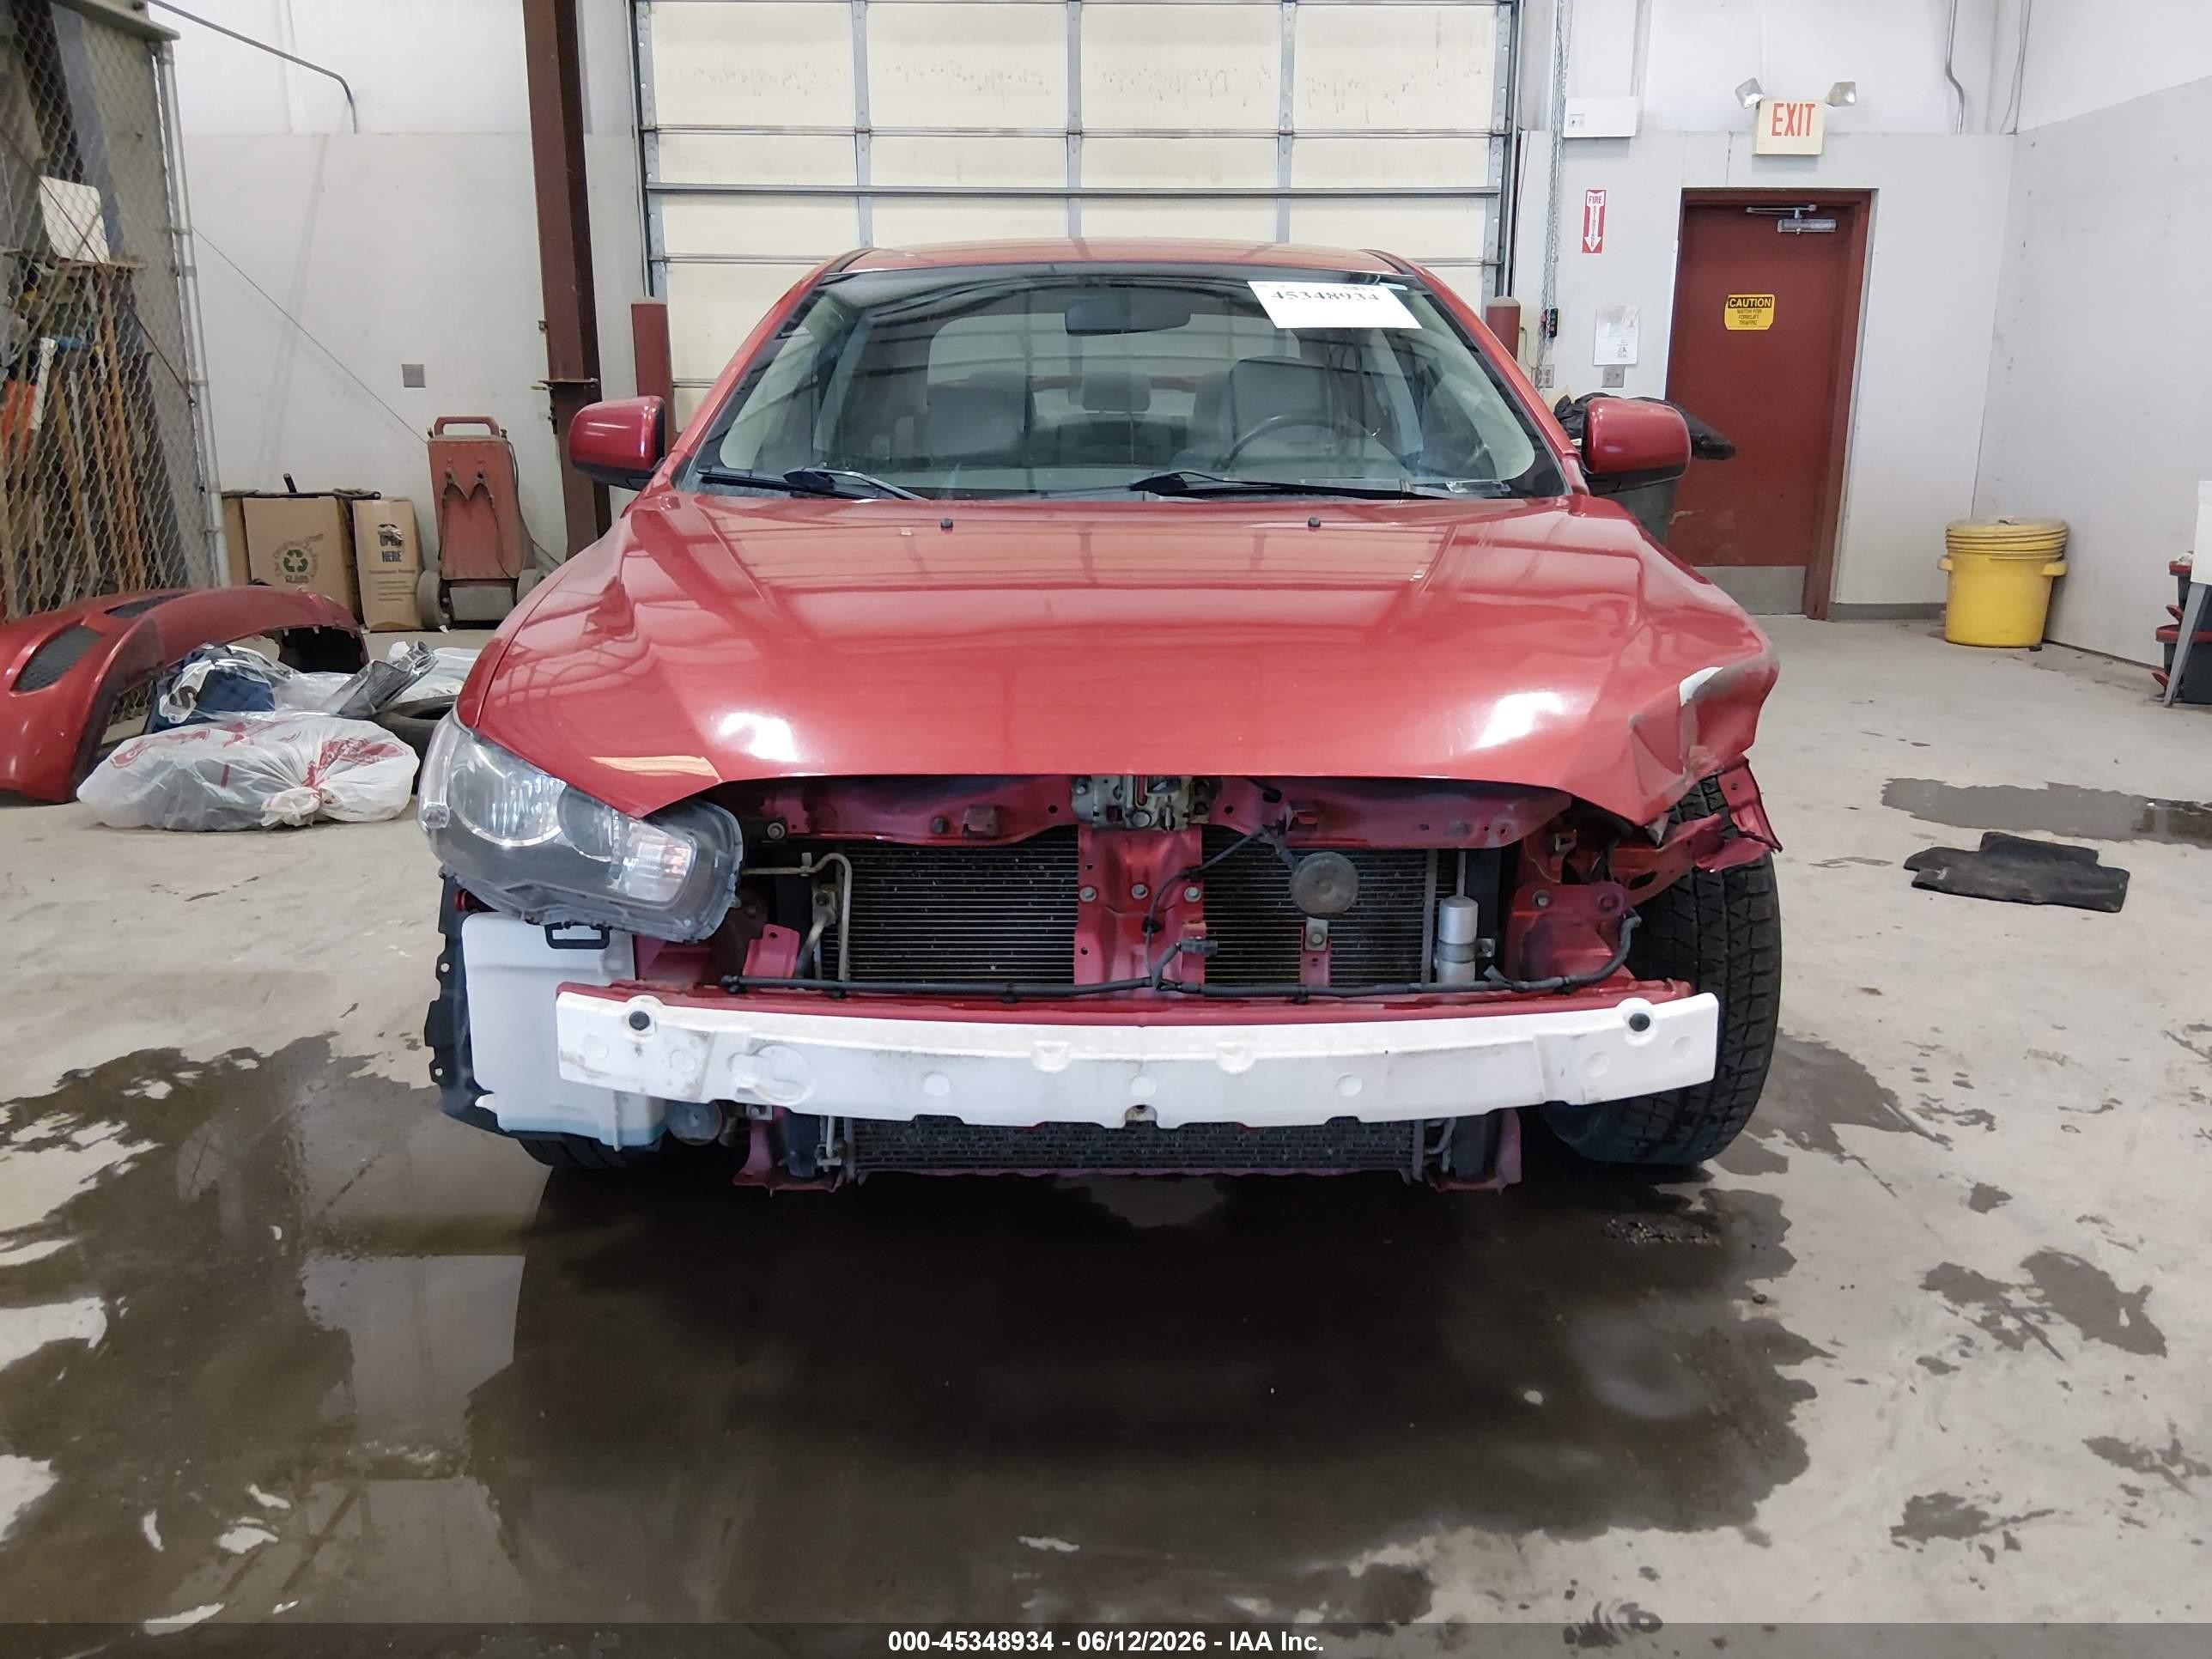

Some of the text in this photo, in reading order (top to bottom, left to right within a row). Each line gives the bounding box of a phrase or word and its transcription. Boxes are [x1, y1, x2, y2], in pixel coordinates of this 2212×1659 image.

[1771, 102, 1815, 137] EXIT
[1589, 195, 1602, 204] FIRE
[1272, 290, 1381, 301] 45348934
[1729, 298, 1771, 307] CAUTION
[382, 550, 402, 562] HERE
